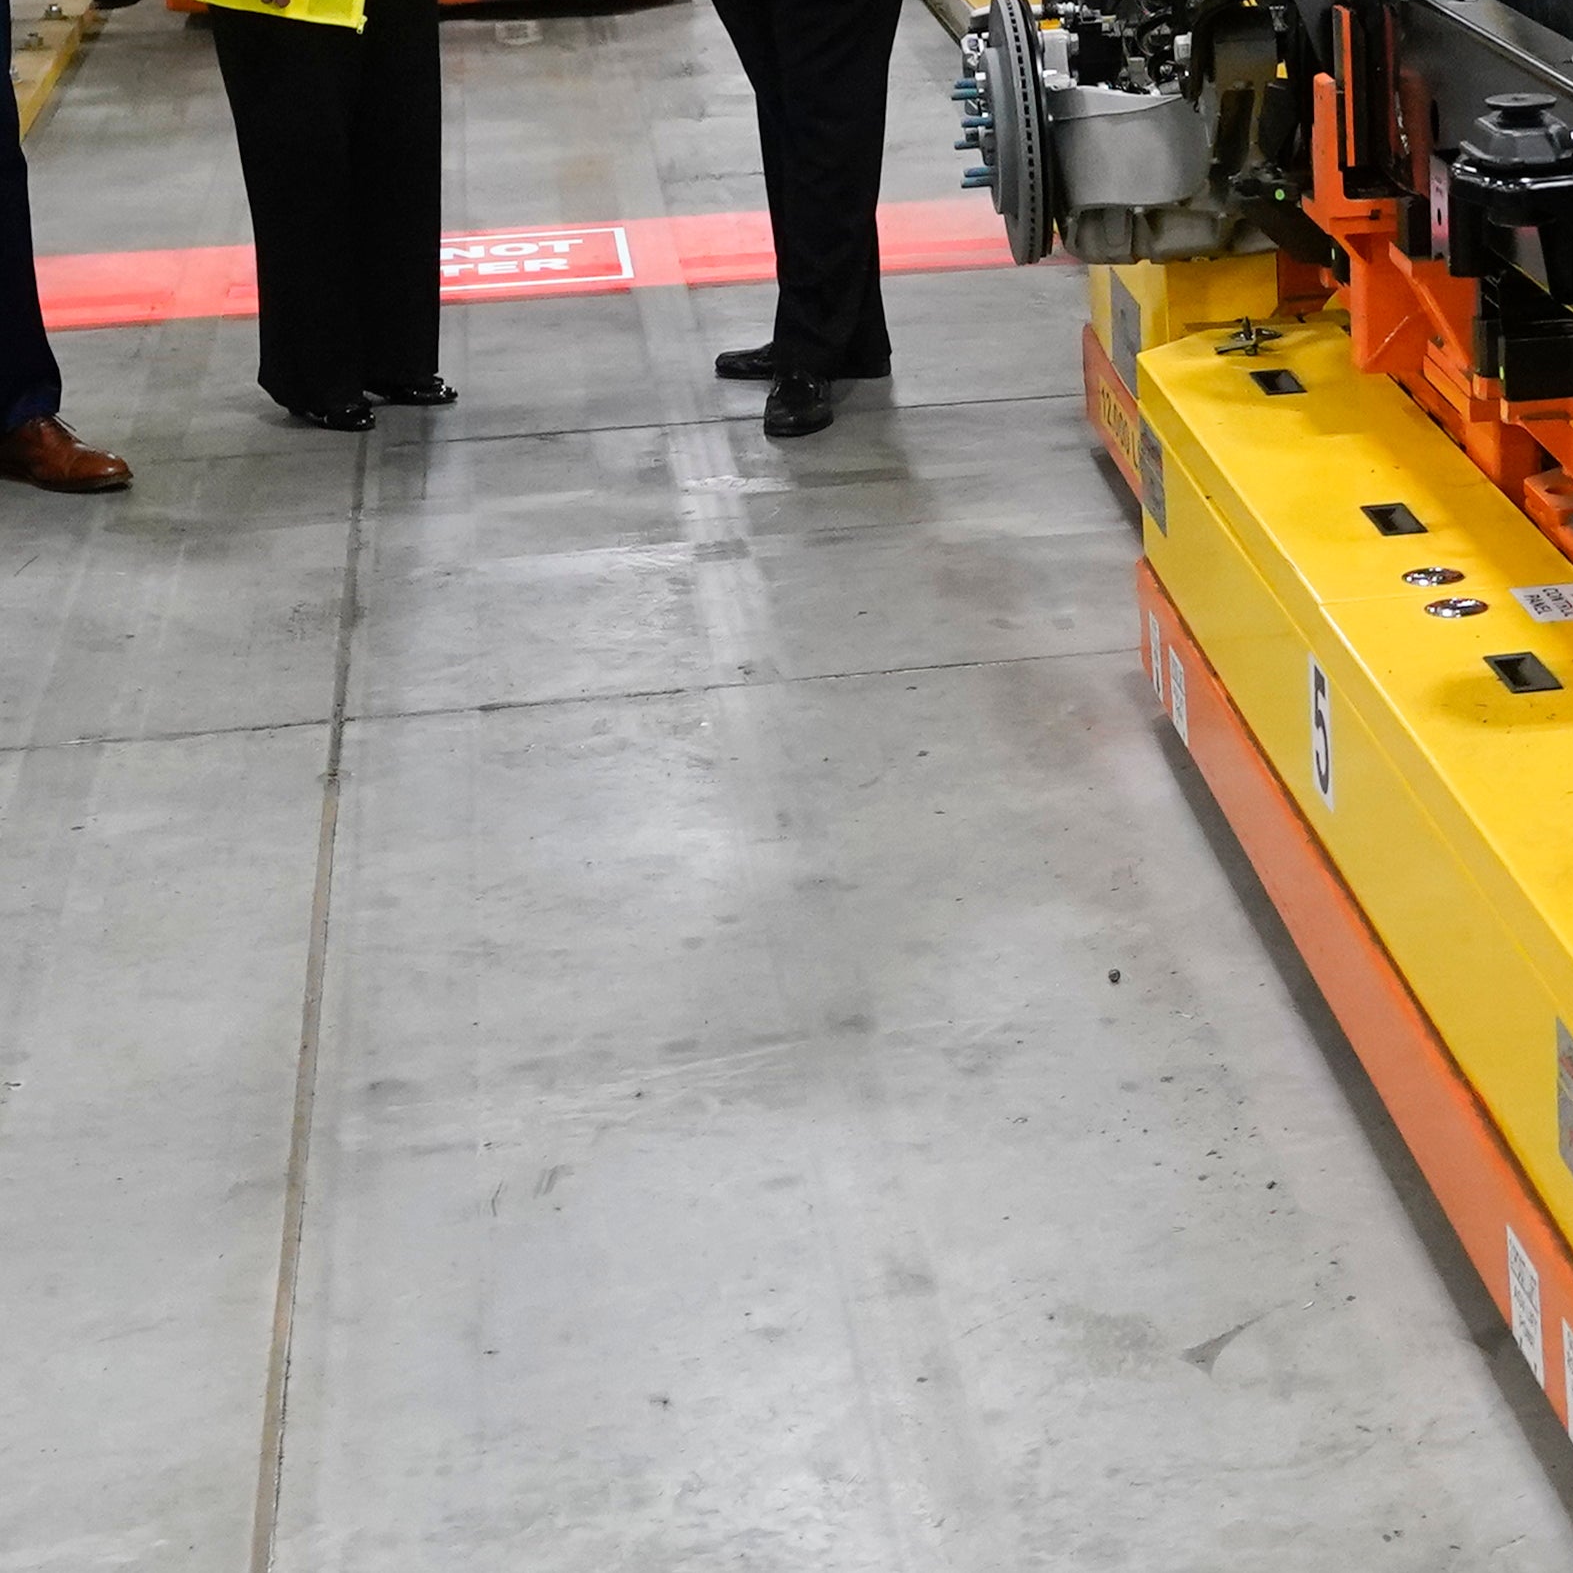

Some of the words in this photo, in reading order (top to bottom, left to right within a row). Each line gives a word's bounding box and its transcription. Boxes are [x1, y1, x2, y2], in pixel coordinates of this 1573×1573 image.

[440, 239, 583, 260] NOT
[440, 258, 570, 277] TER
[1523, 594, 1553, 615] PANEL
[1313, 664, 1330, 795] 5
